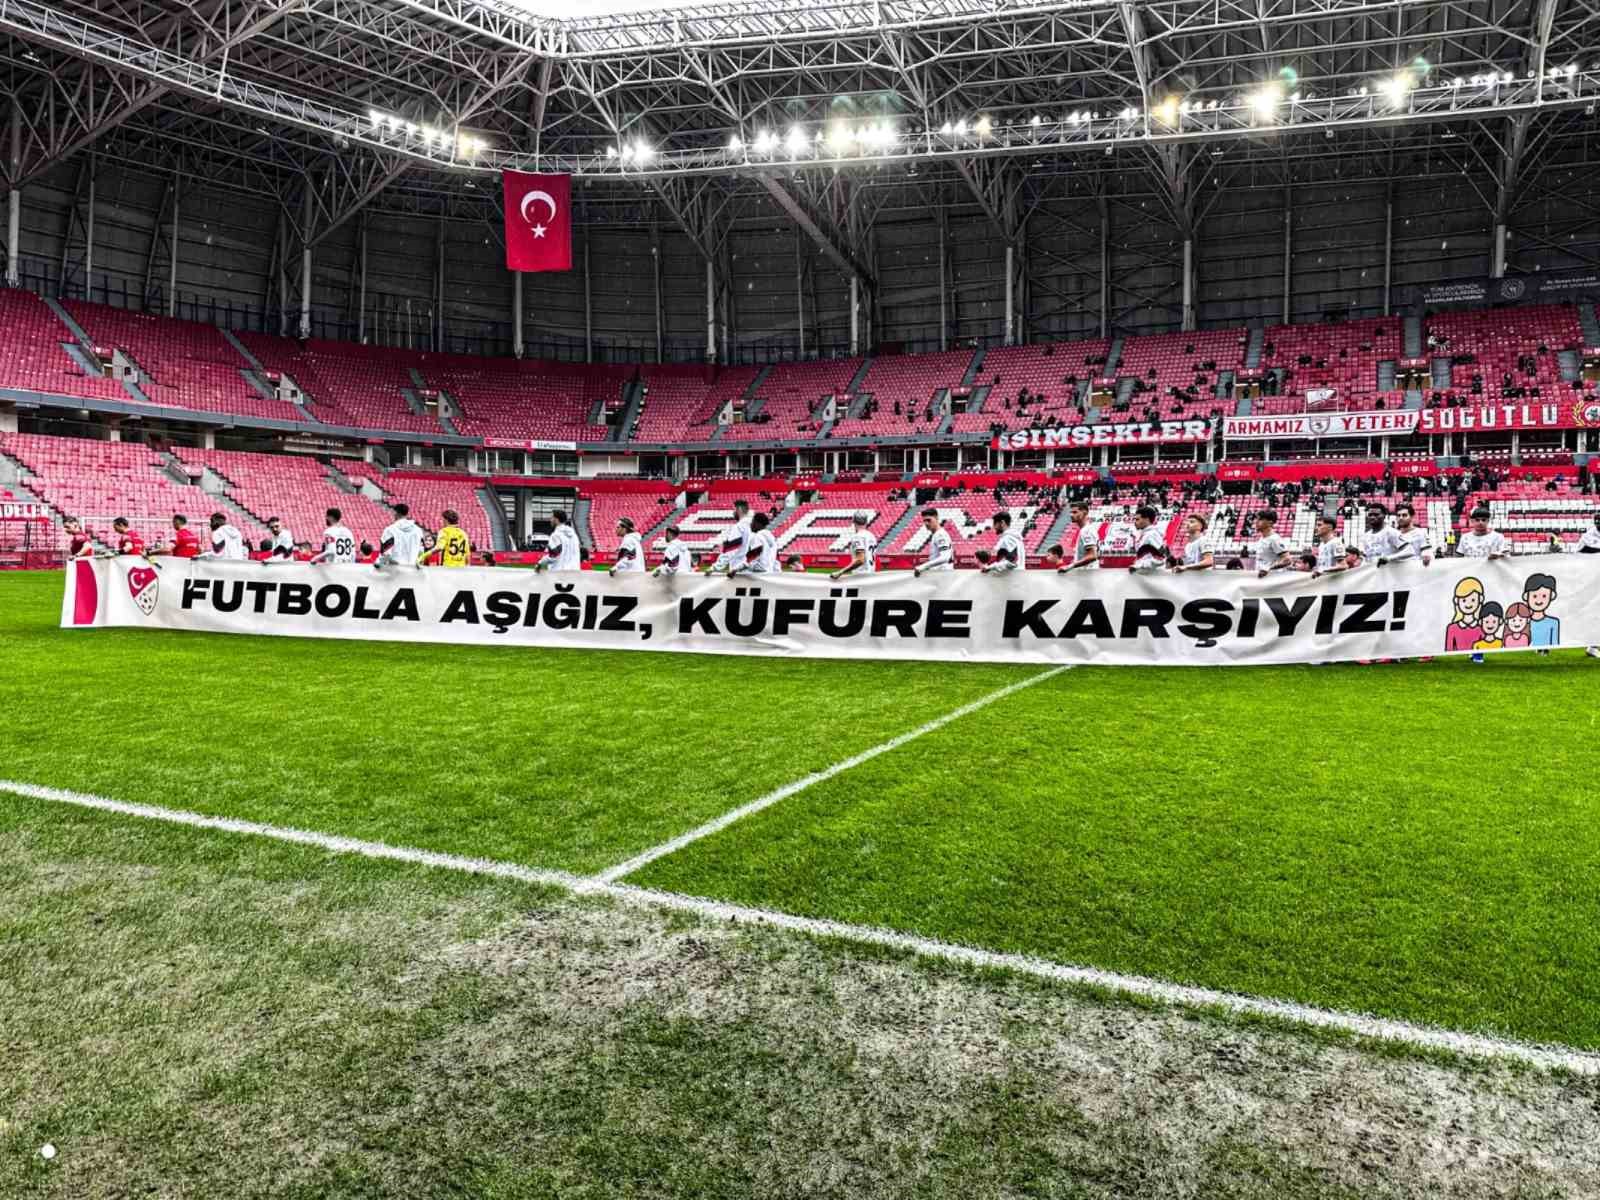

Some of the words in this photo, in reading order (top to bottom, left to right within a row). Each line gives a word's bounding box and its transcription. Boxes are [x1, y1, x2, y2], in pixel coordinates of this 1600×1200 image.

[1227, 420, 1304, 434] ARMAMIZ
[1341, 413, 1414, 431] YETER!
[336, 538, 352, 556] 68
[449, 538, 466, 556] 54
[181, 579, 420, 621] FUTBOLA
[440, 583, 652, 640] AŞIĞIZ,
[678, 587, 973, 638] KÜFÜRE
[1002, 590, 1411, 648] KARŞIYIZ!
